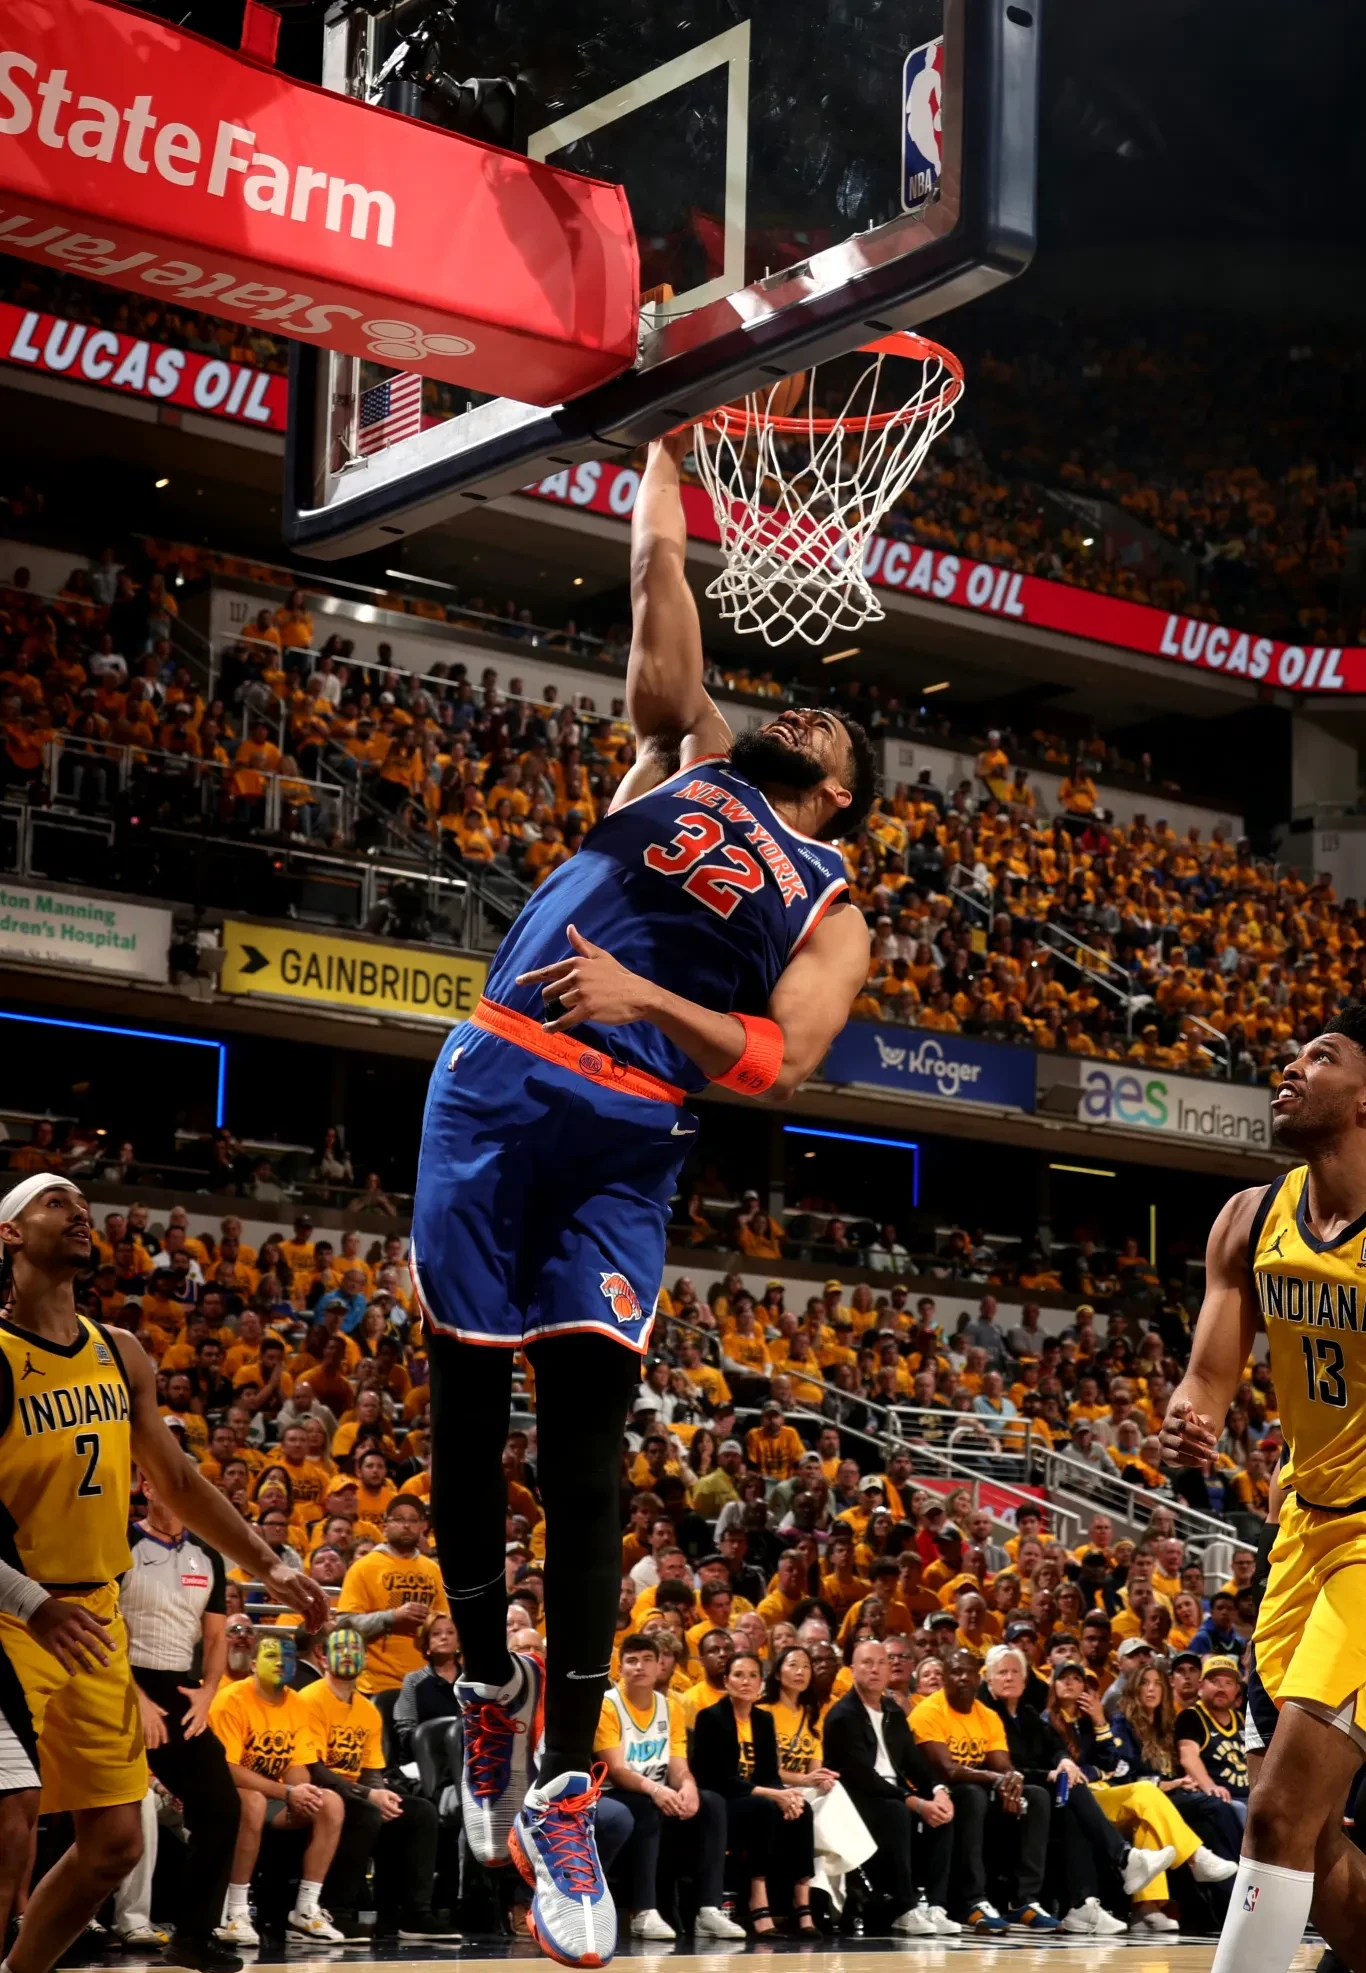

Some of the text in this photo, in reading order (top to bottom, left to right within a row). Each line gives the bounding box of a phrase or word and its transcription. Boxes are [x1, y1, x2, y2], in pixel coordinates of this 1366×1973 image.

[908, 168, 932, 201] NBA
[10, 312, 273, 422] LUCAS OIL
[831, 533, 1025, 617] LUCAS OIL
[1158, 613, 1345, 688] LUCAS OIL
[642, 812, 765, 920] 32
[672, 779, 808, 908] NEW YORK
[35, 894, 117, 928] Manning
[60, 922, 138, 951] Hospital
[279, 947, 474, 1013] GAINBRIDGE
[908, 1039, 982, 1097] Kroger
[1083, 1070, 1267, 1144] aes Indiana
[1257, 1271, 1366, 1334] INDIAN
[1301, 1335, 1348, 1409] 13
[17, 1383, 131, 1438] INDIANA
[74, 1432, 103, 1498] 2
